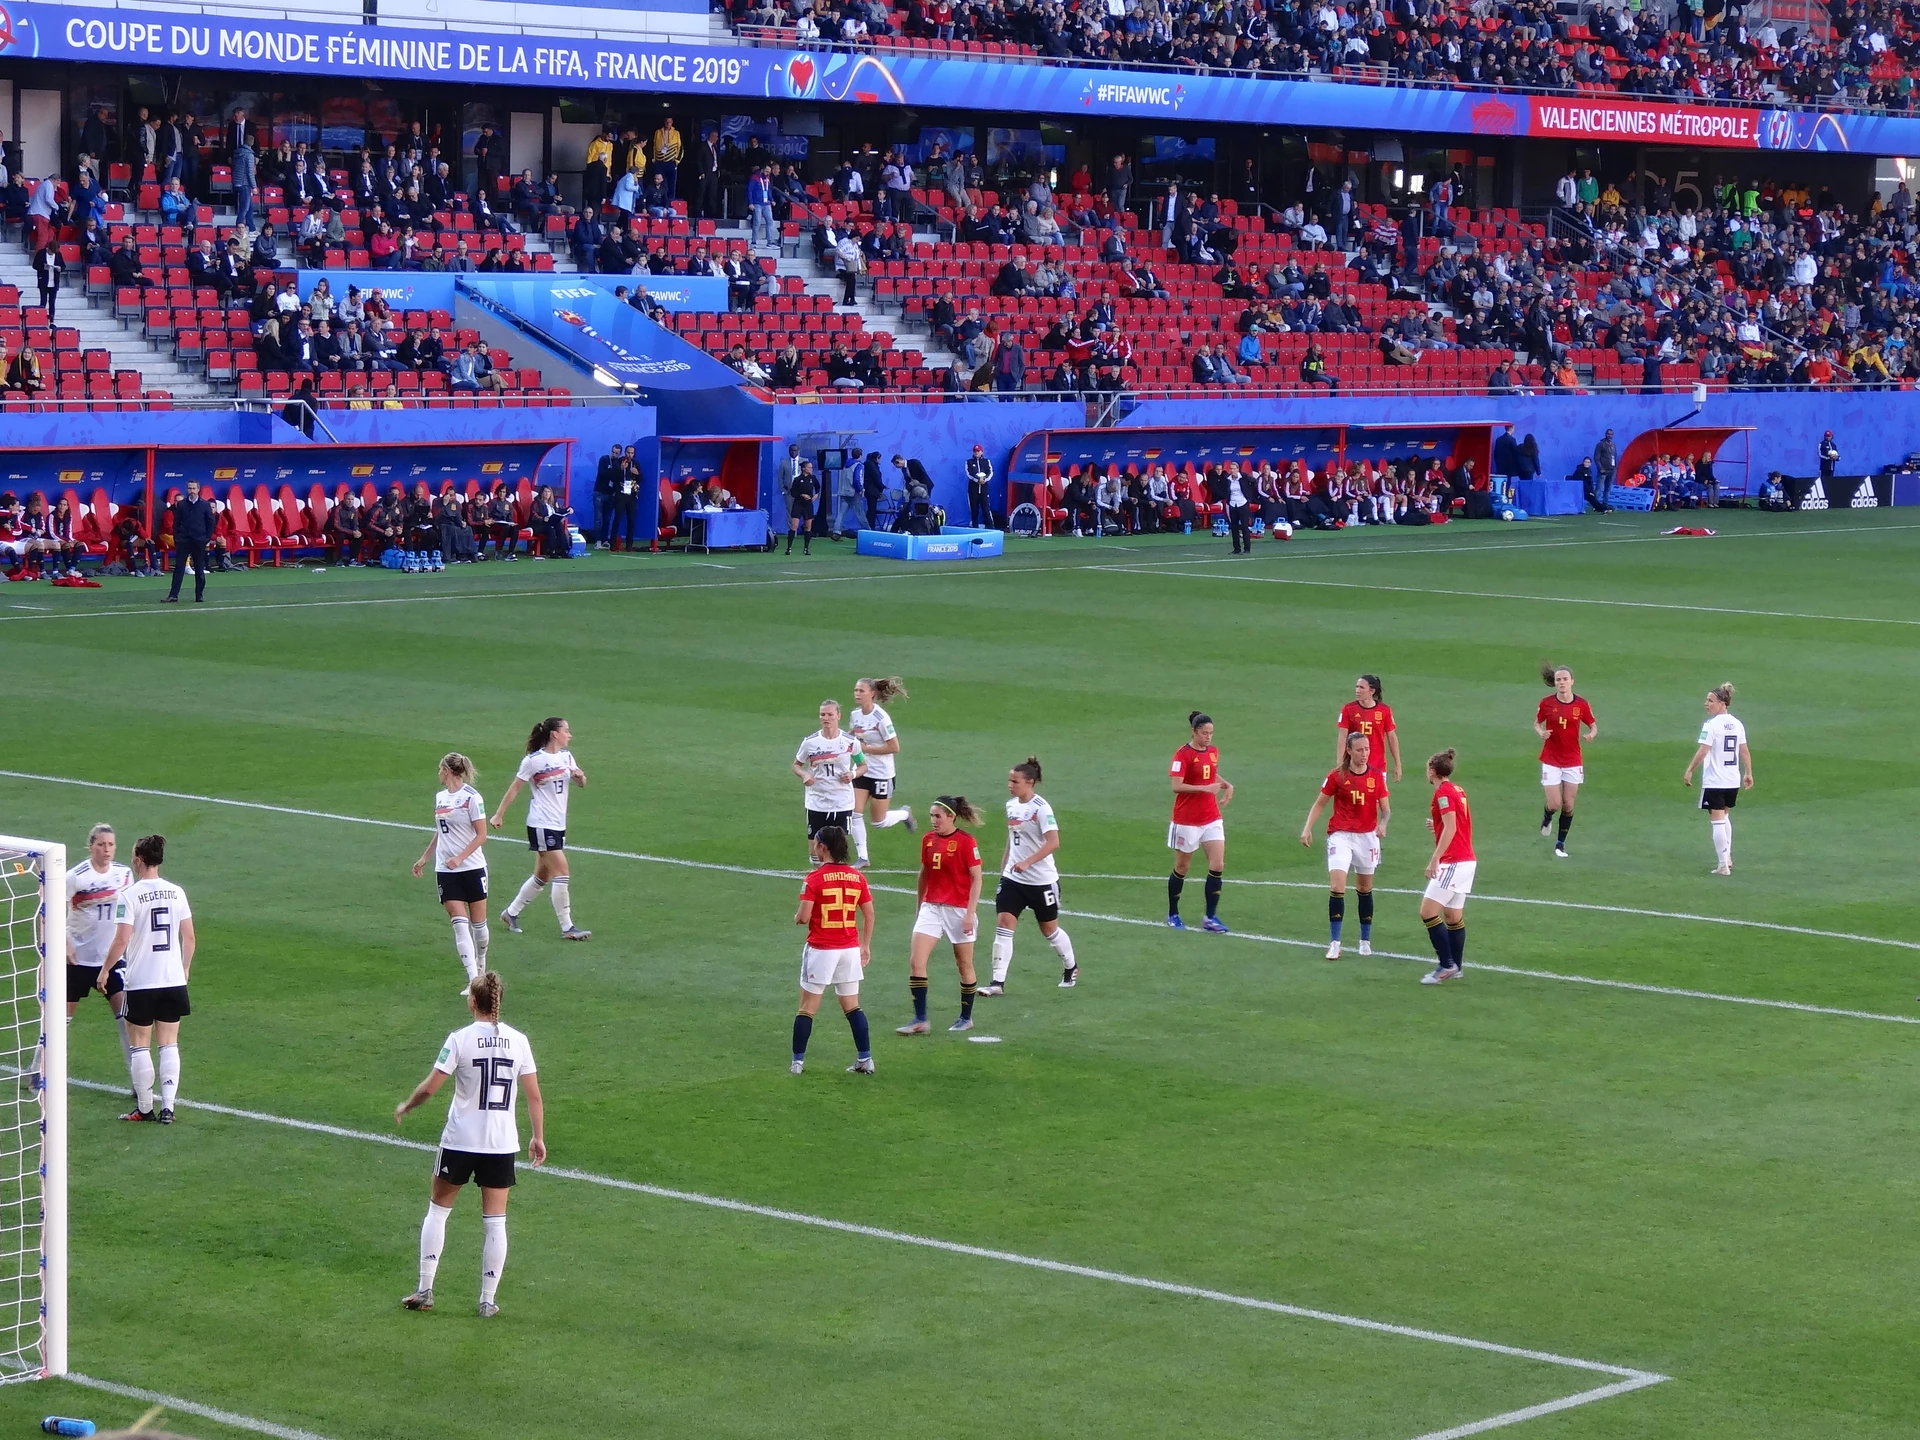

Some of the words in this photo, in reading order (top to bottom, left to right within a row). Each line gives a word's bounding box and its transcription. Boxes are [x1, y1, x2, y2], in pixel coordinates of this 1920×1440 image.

[66, 18, 163, 53] COUPE
[171, 25, 210, 56] DU
[219, 29, 320, 64] MONDE
[325, 31, 452, 71] FÉMININE
[458, 42, 491, 72] DE
[498, 46, 529, 75] LA
[533, 47, 589, 81] FIFA,
[595, 51, 687, 83] FRANCE
[1097, 84, 1170, 106] #FIFAWWC
[1539, 106, 1656, 135] VALENCIENNES
[1660, 109, 1749, 139] MÉTROPOLE
[550, 287, 596, 299] FIFA
[1801, 498, 1829, 510] adidas
[1851, 497, 1878, 508] adidas
[1360, 721, 1372, 735] 15
[1558, 716, 1567, 730] 4
[1723, 735, 1738, 766] 9
[824, 764, 835, 776] 11
[1202, 764, 1211, 780] 8
[553, 780, 564, 794] 13
[874, 781, 888, 796] 19
[1350, 790, 1365, 805] 14
[931, 853, 942, 869] 9
[138, 890, 178, 904] HEGERING
[1044, 889, 1055, 907] 6
[97, 904, 112, 920] 17
[821, 888, 862, 929] 22
[151, 907, 171, 952] 5
[477, 1036, 510, 1049] GWINN
[472, 1057, 515, 1111] 15
